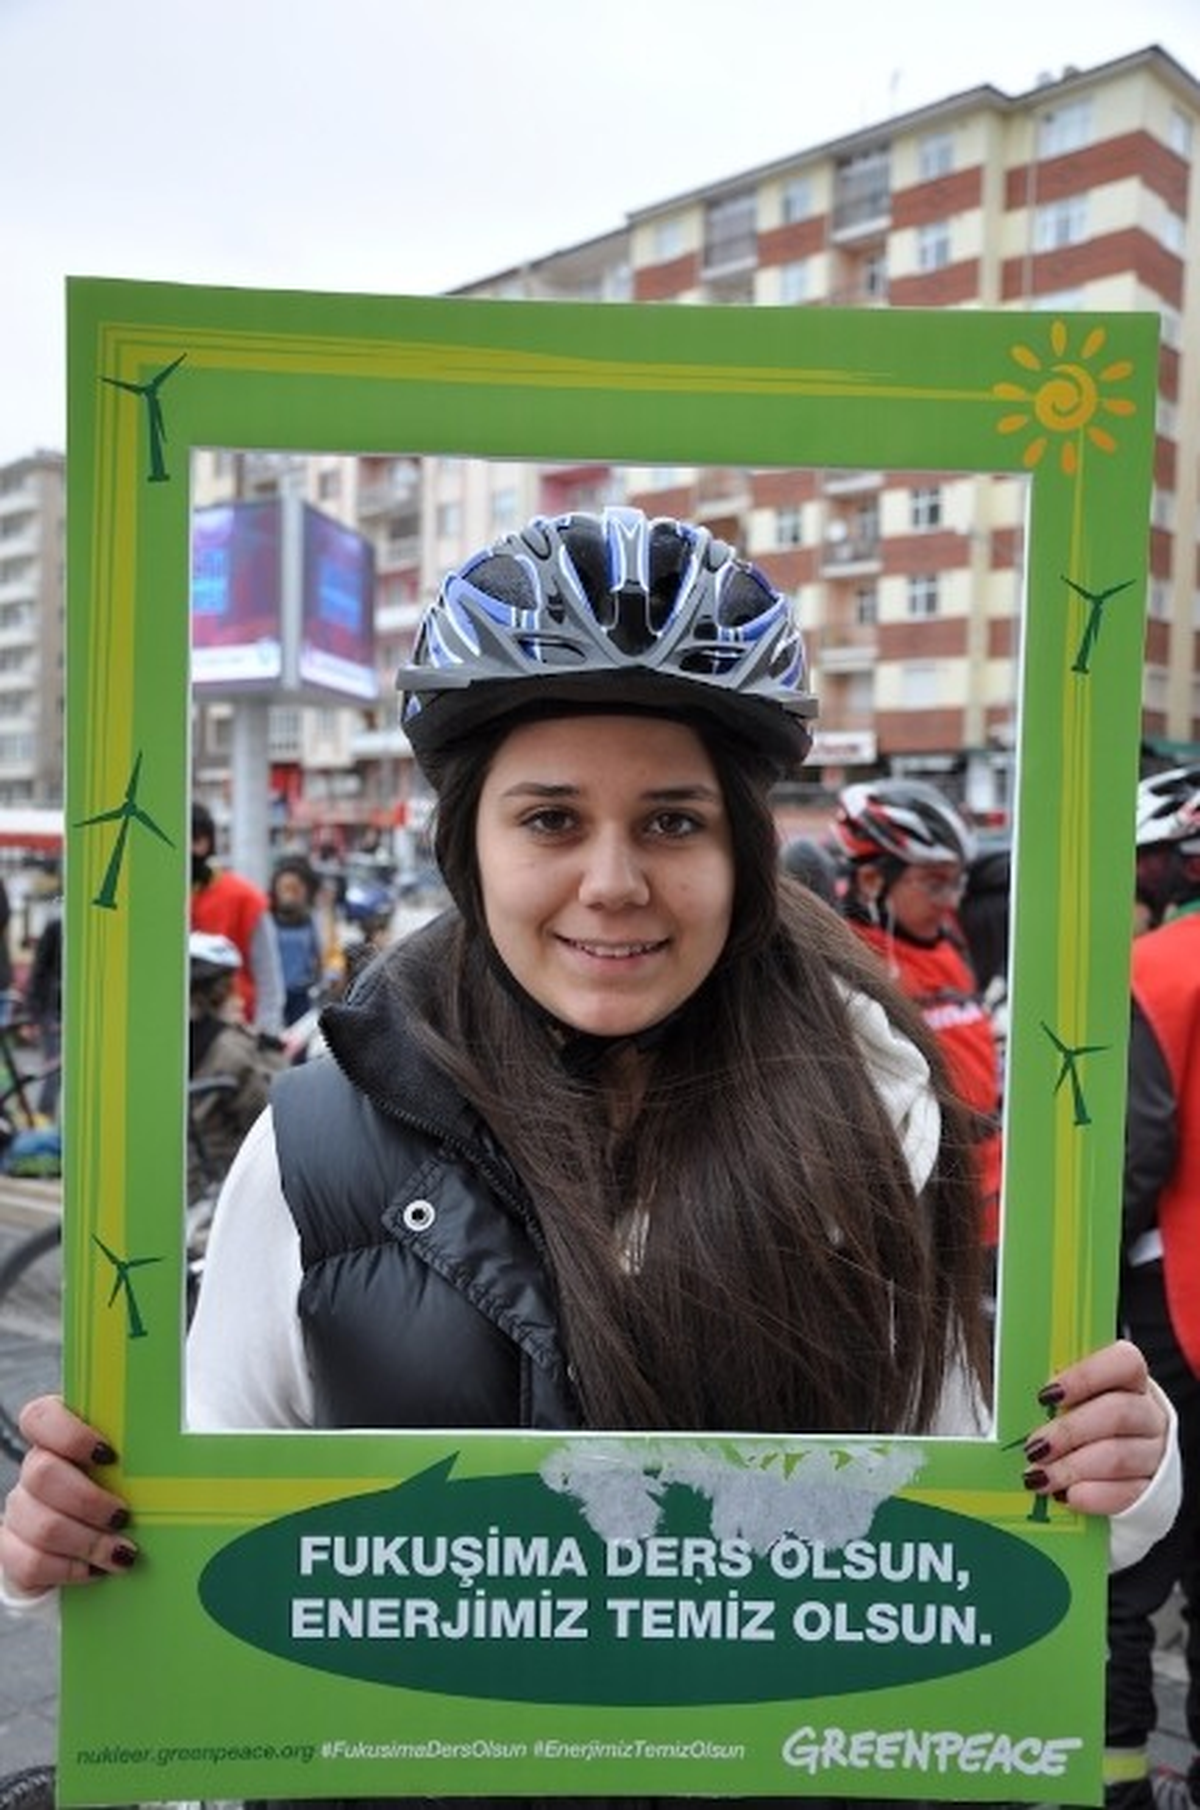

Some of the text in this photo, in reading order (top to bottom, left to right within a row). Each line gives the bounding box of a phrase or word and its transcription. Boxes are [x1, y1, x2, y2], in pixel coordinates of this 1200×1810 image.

[299, 1526, 970, 1591] FUKUŞİMA DERS OLSUN,
[291, 1589, 992, 1646] ENERJİMİZ TEMİZ OLSUN.
[77, 1744, 315, 1766] nukleer.greenpeace.org
[320, 1740, 527, 1760] #FukusimaDersOlsun
[782, 1726, 1083, 1776] GREENPEACE
